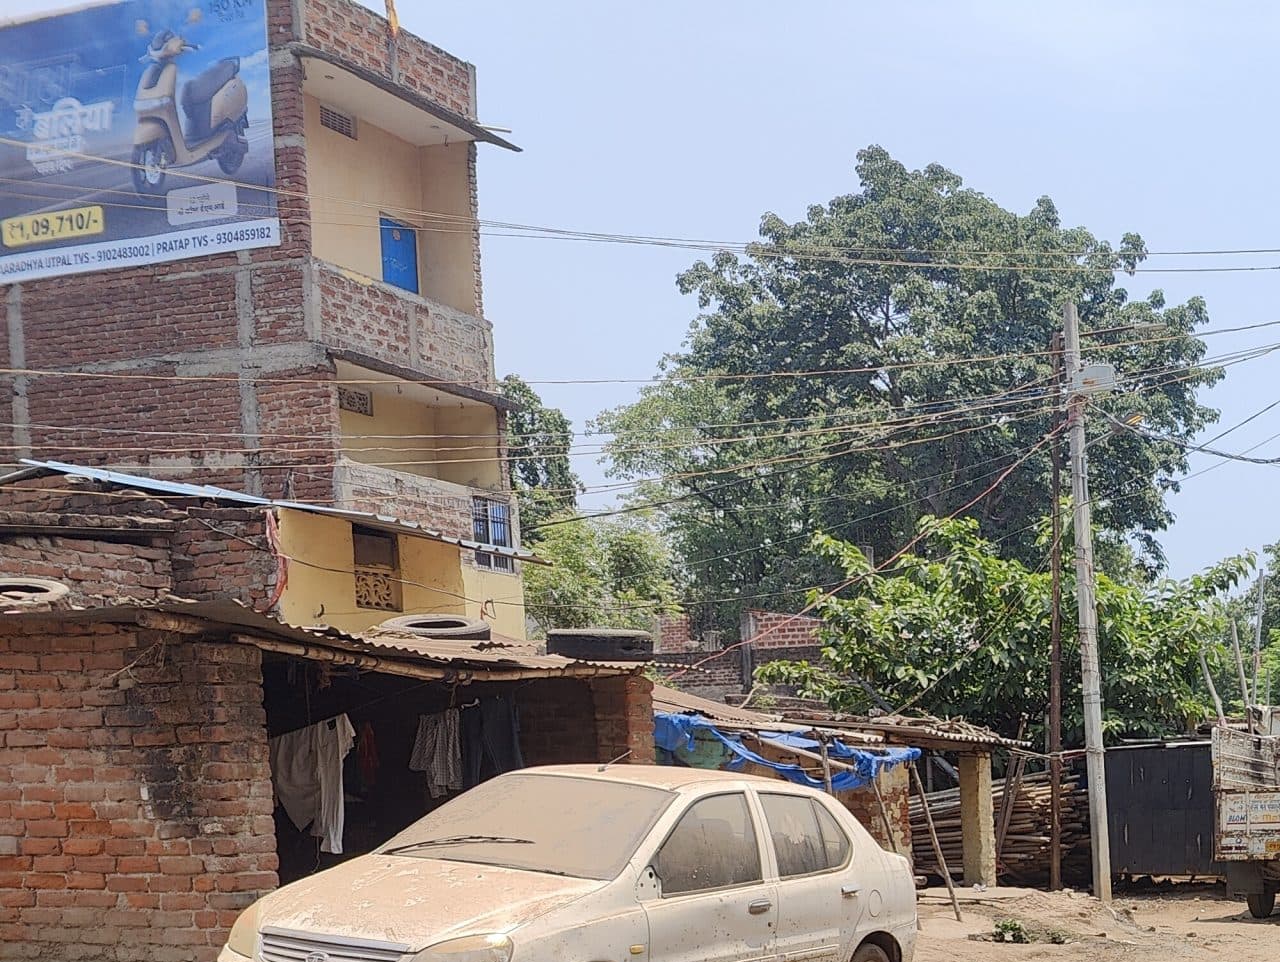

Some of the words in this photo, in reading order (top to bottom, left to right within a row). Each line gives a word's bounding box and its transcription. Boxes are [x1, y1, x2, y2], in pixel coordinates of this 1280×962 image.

[44, 252, 72, 269] UTPAL
[73, 252, 90, 265] TVS
[96, 244, 150, 262] 9102483002
[156, 238, 190, 254] PRATAP
[191, 234, 209, 249] TVS
[216, 226, 272, 245] 9304859182
